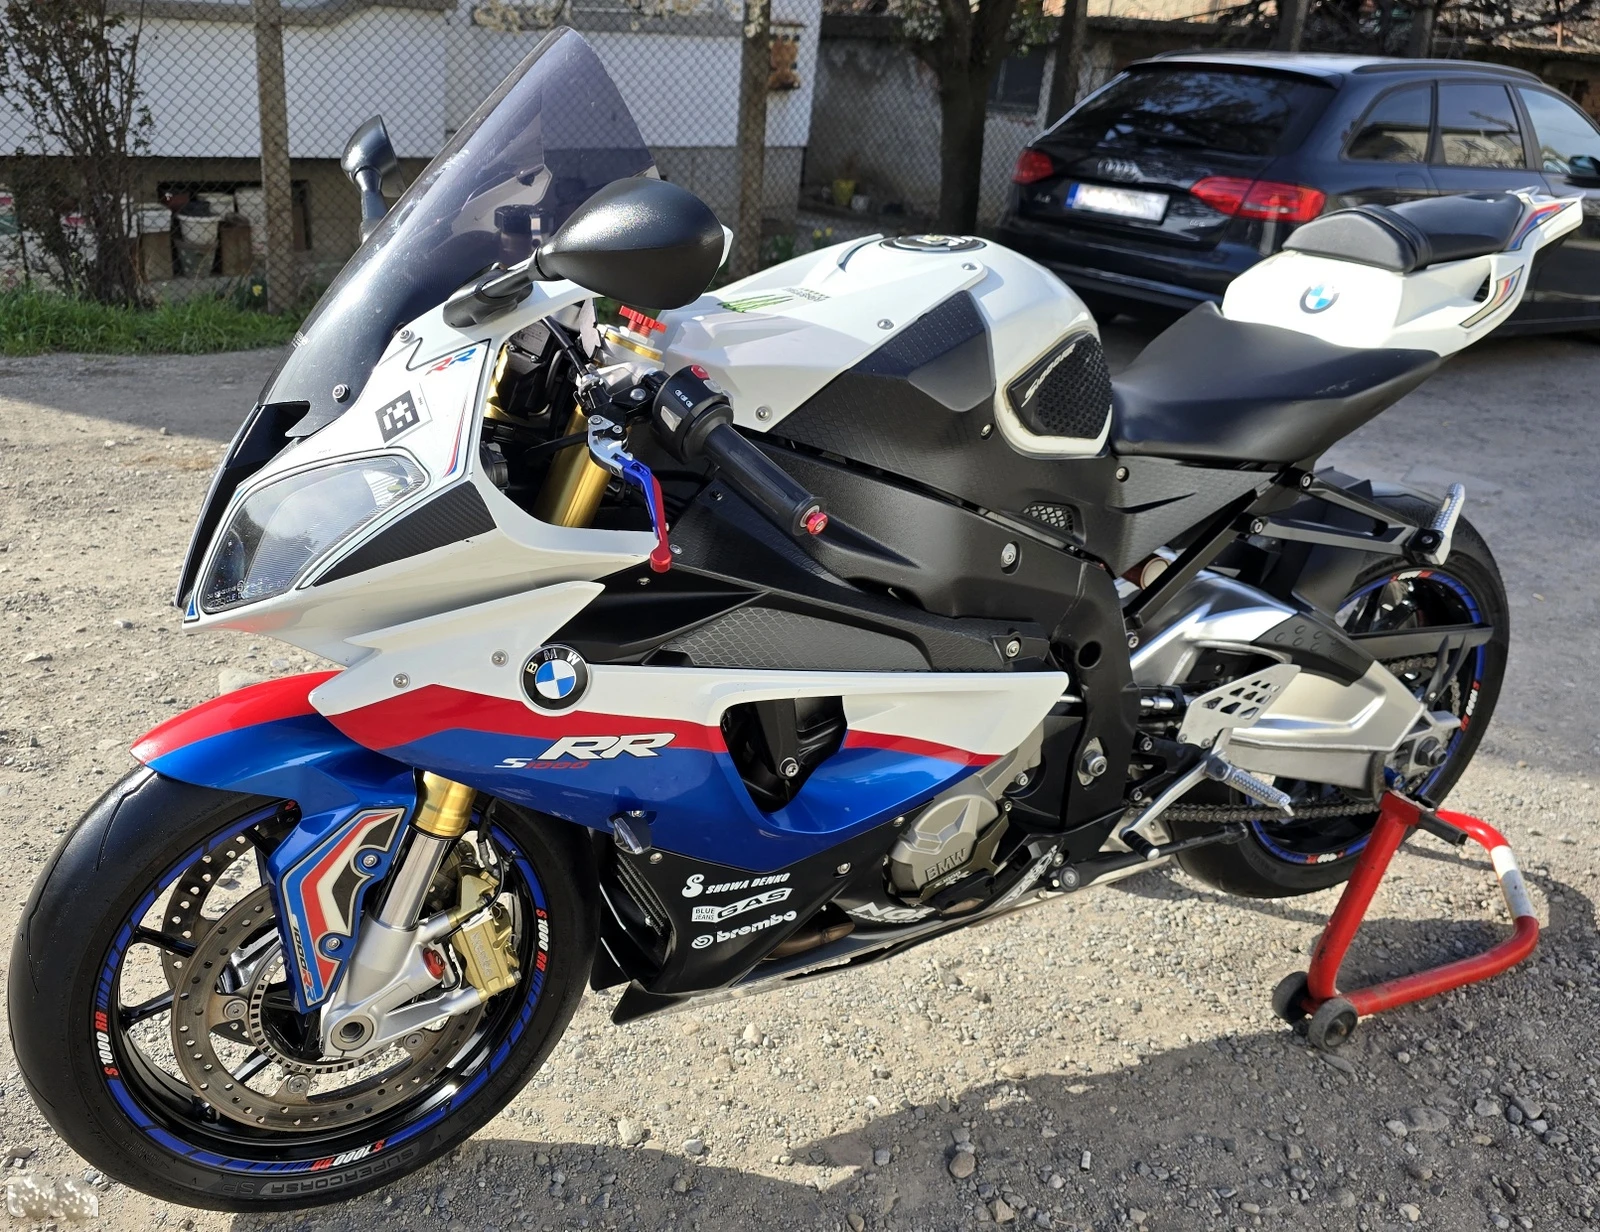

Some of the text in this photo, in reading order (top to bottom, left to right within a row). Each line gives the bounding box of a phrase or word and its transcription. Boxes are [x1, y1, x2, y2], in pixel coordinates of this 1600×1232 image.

[526, 648, 580, 675] BMW
[537, 733, 676, 760] RR
[924, 848, 966, 881] BMW
[705, 880, 749, 894] SHOWA
[751, 872, 791, 888] DENKO
[537, 918, 549, 952] 1000
[717, 910, 797, 943] brembo
[95, 1010, 119, 1076] S 1000 RR
[270, 1148, 415, 1194] SUPERCORSA
[333, 1145, 372, 1167] 1000
